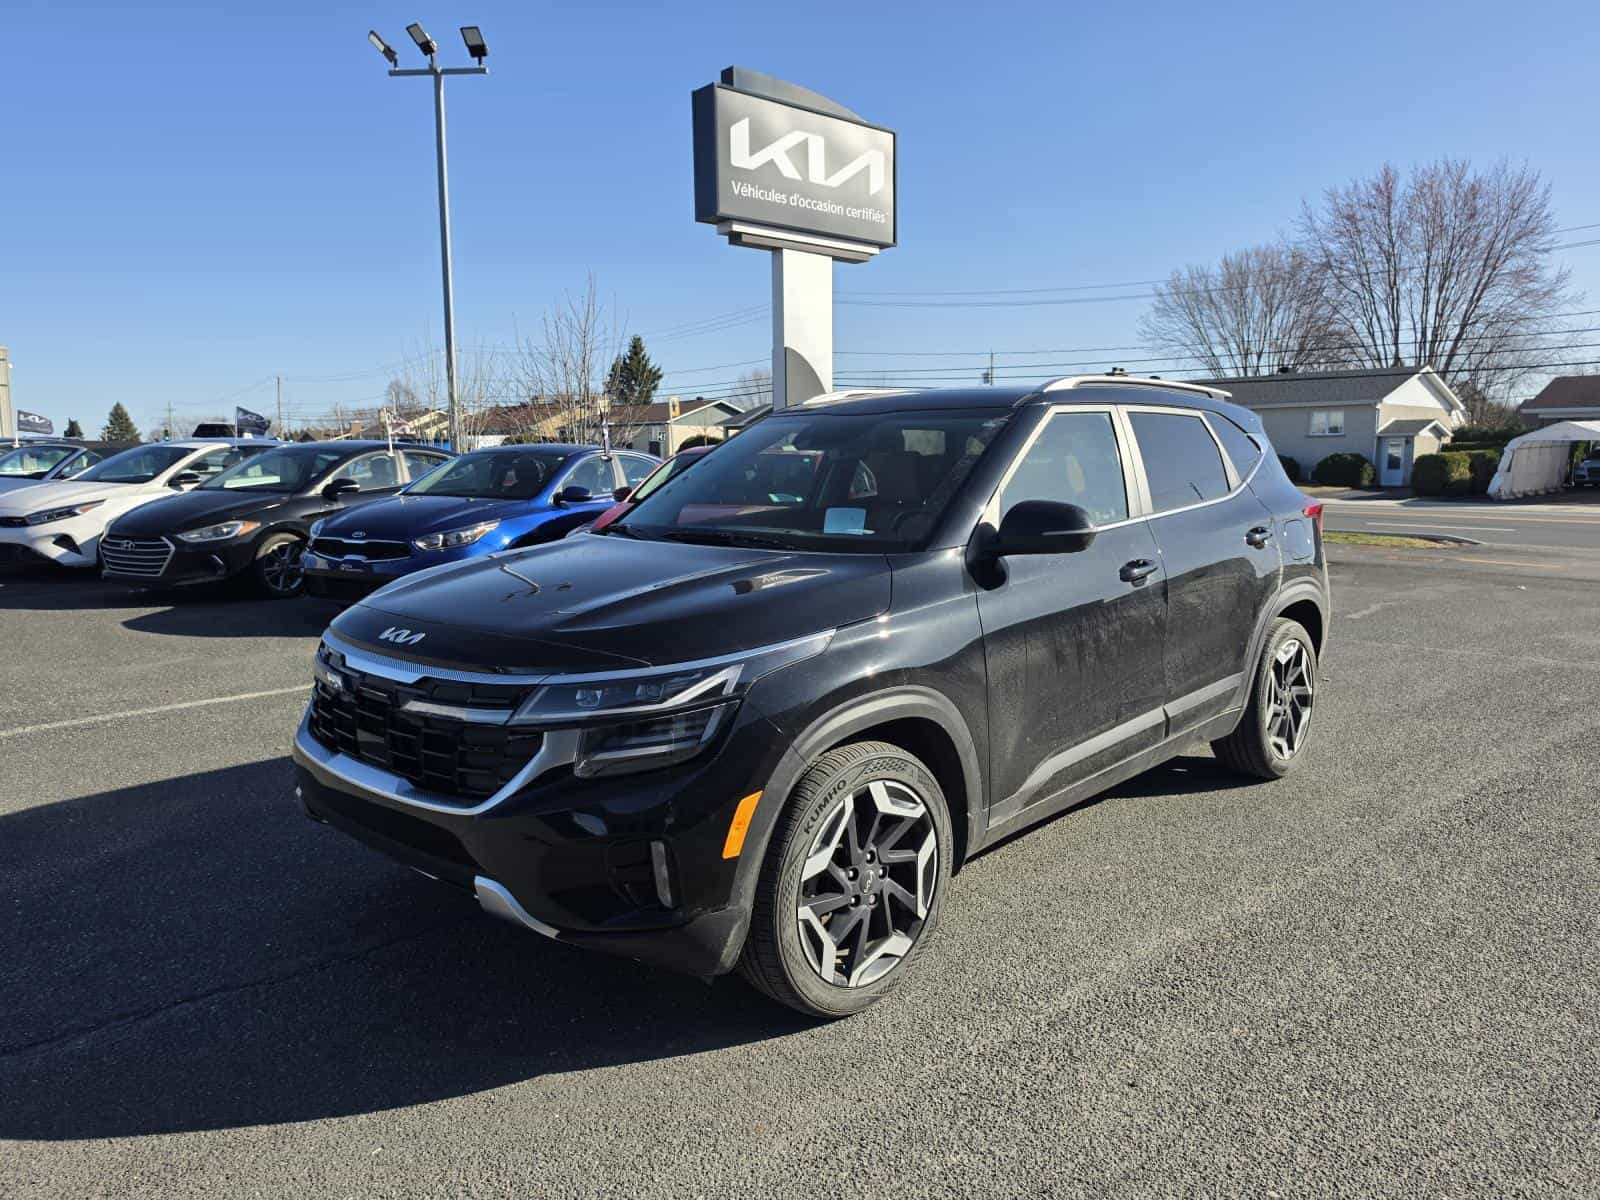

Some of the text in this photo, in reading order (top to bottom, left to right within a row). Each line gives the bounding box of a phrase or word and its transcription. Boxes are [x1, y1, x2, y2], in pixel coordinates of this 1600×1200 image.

[730, 116, 885, 196] KIA
[731, 180, 885, 224] Véhicules d'occasion certifiés
[378, 626, 426, 645] KIA
[803, 779, 847, 834] KUMHO
